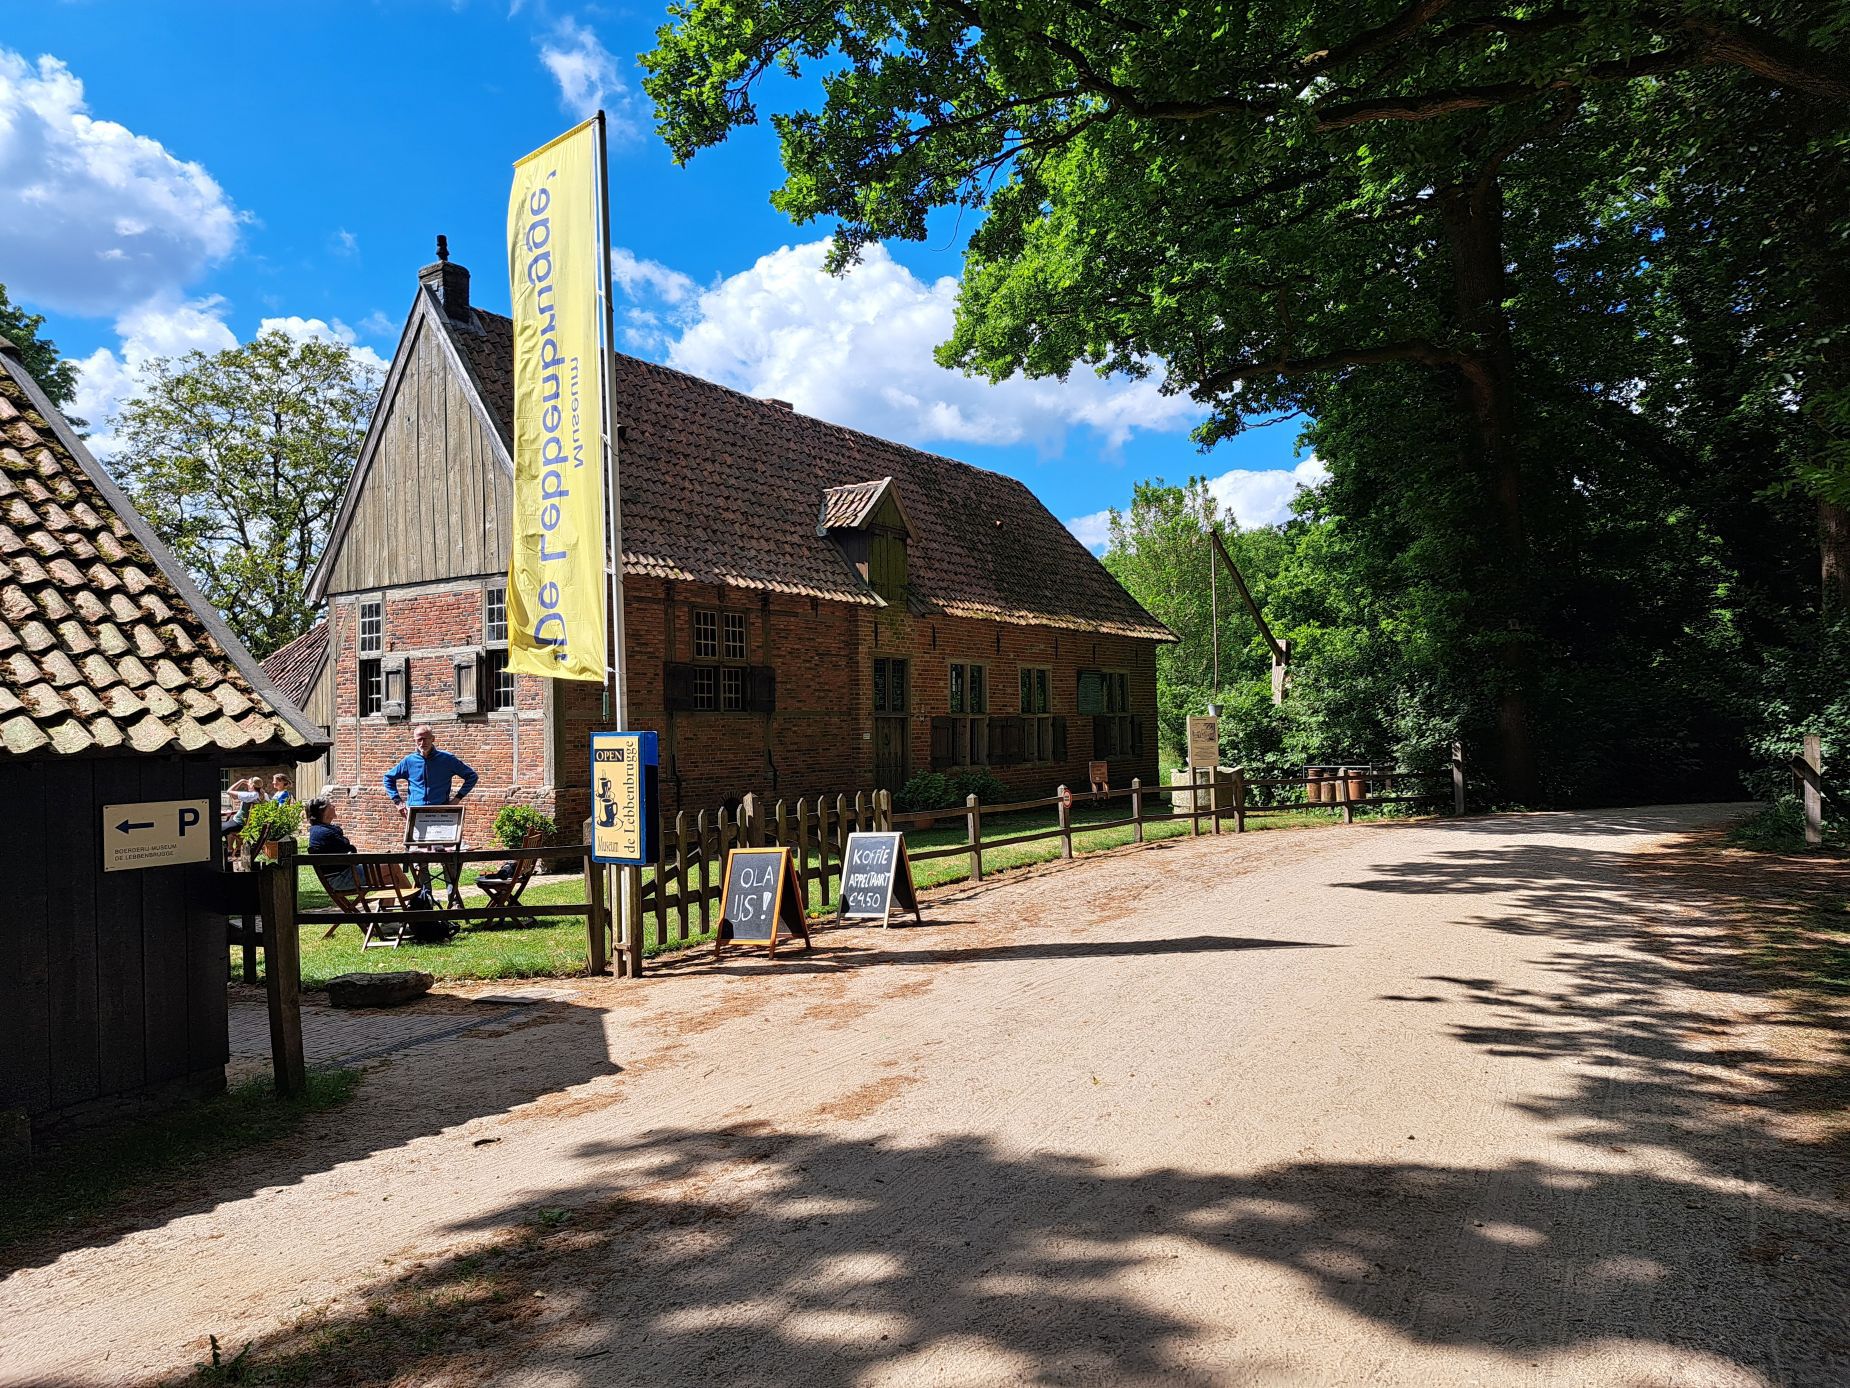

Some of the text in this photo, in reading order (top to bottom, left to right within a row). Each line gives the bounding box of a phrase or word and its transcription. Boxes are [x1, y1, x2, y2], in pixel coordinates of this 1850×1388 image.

[596, 750, 623, 762] OPEN
[623, 741, 637, 853] de Lebbenbrugge
[179, 808, 200, 836] P
[151, 843, 177, 851] MUSEUM
[740, 865, 774, 888] OLA
[848, 872, 891, 888] APPELTAART
